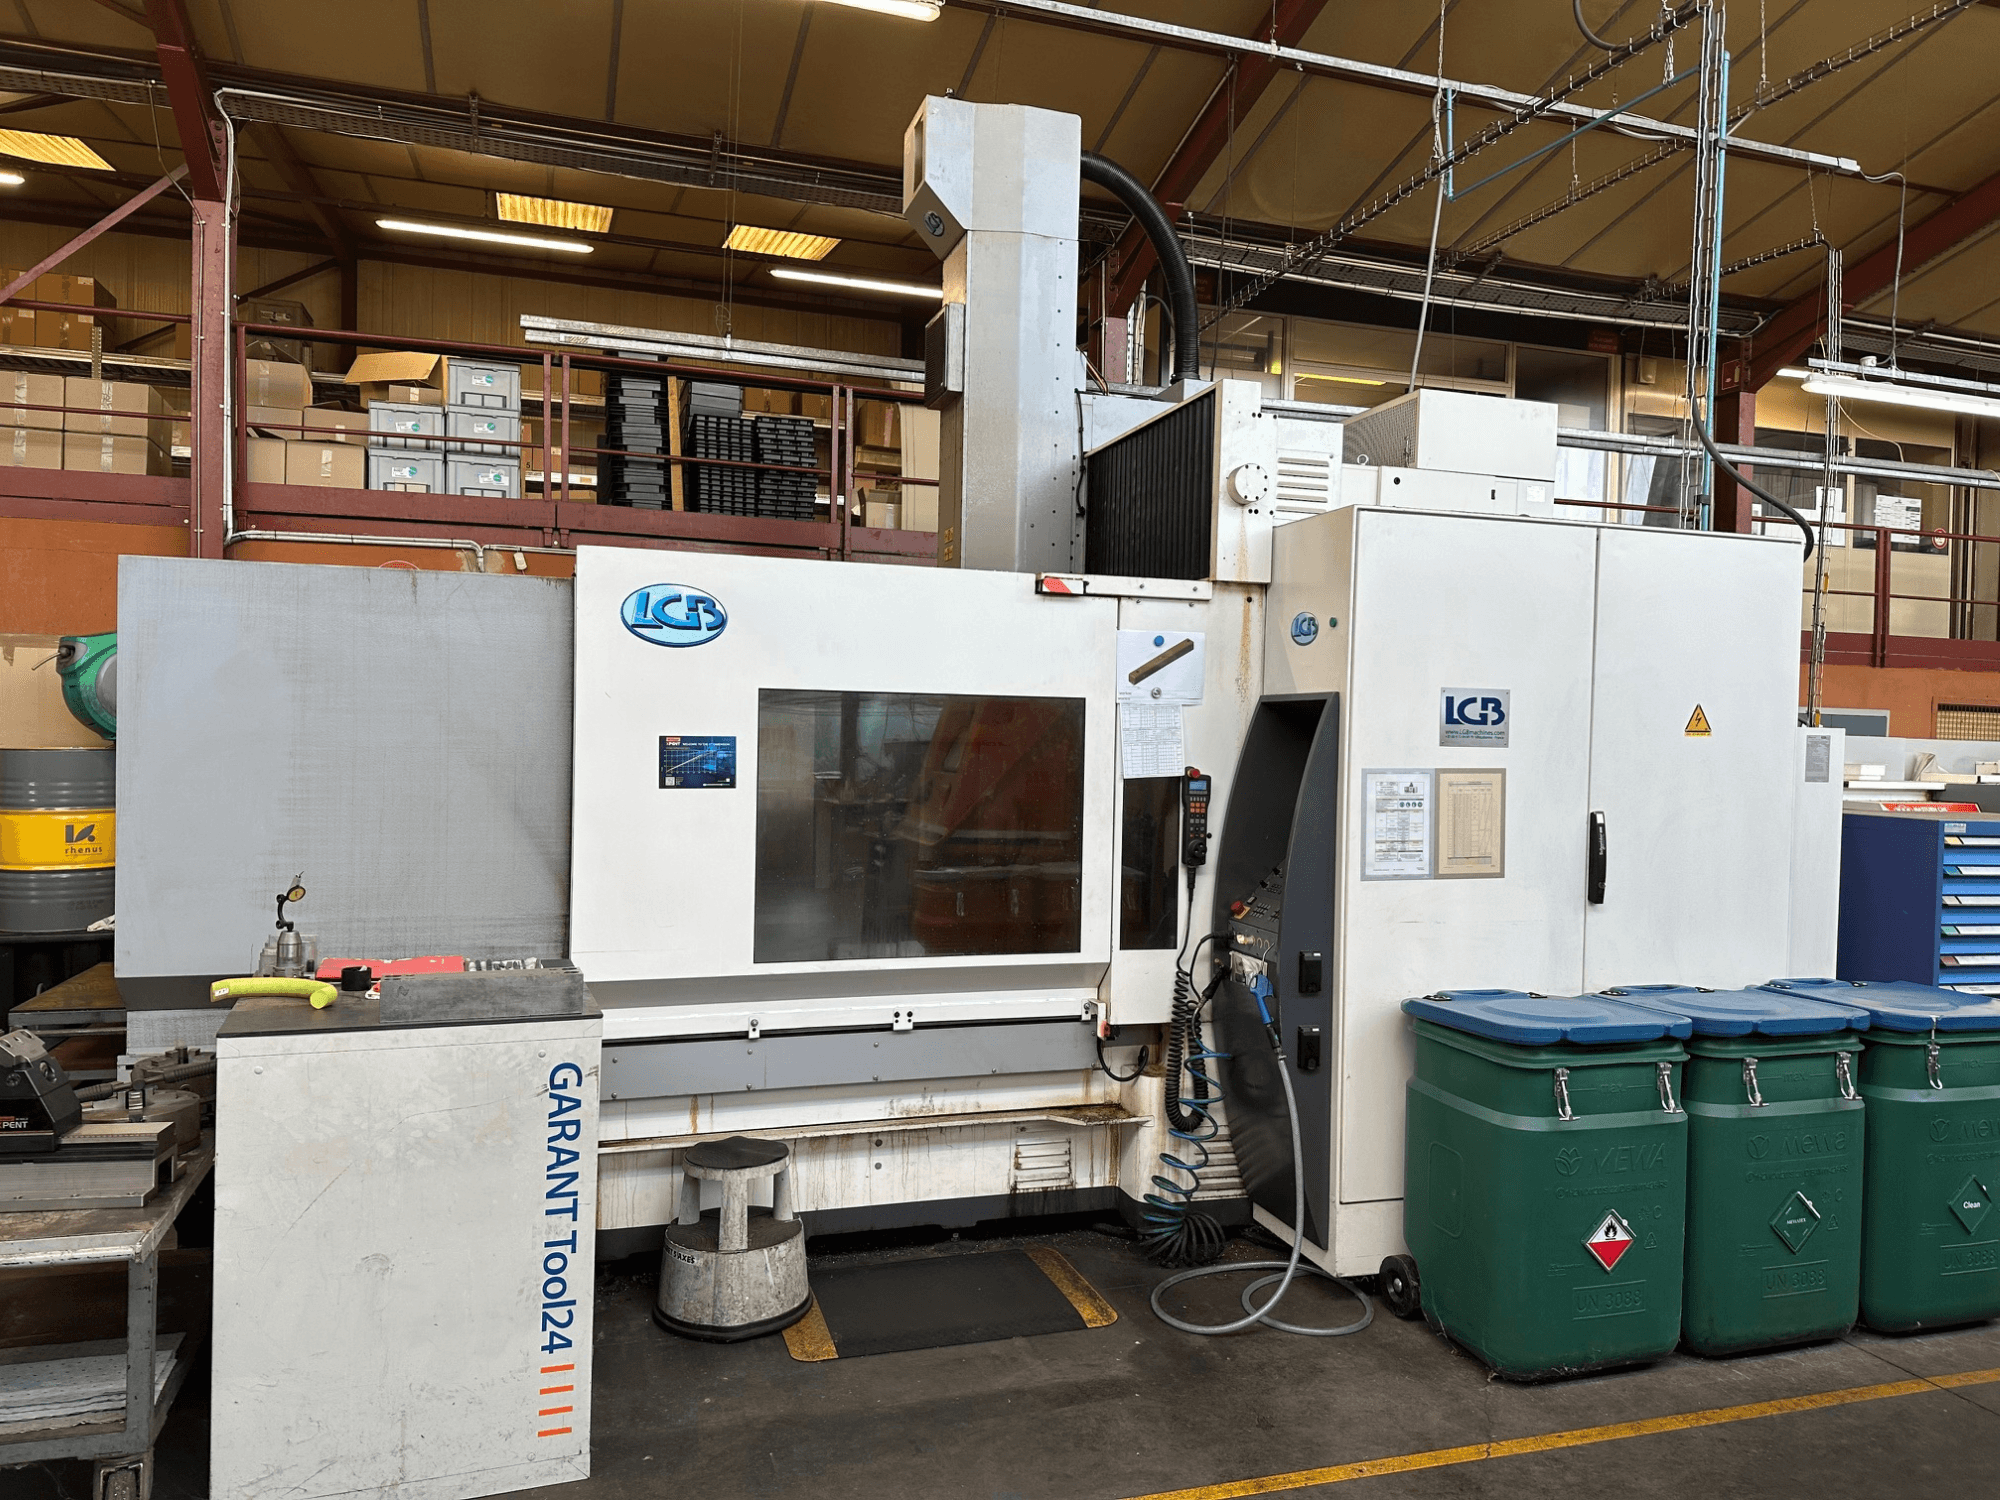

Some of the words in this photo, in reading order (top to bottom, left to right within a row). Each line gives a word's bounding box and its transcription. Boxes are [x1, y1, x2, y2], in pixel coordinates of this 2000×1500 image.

[631, 591, 725, 631] LGB
[1293, 616, 1318, 637] LGB
[1445, 696, 1505, 725] LGB
[65, 846, 103, 854] rhenus
[545, 1062, 583, 1221] GARANT
[1589, 1143, 1666, 1175] MEWA
[1963, 1201, 1981, 1209] Clean
[541, 1229, 577, 1354] Tool24
[1766, 1274, 1788, 1290] UN
[1792, 1269, 1826, 1288] 3088
[1577, 1294, 1599, 1312] UN
[1605, 1289, 1641, 1309] 3088
